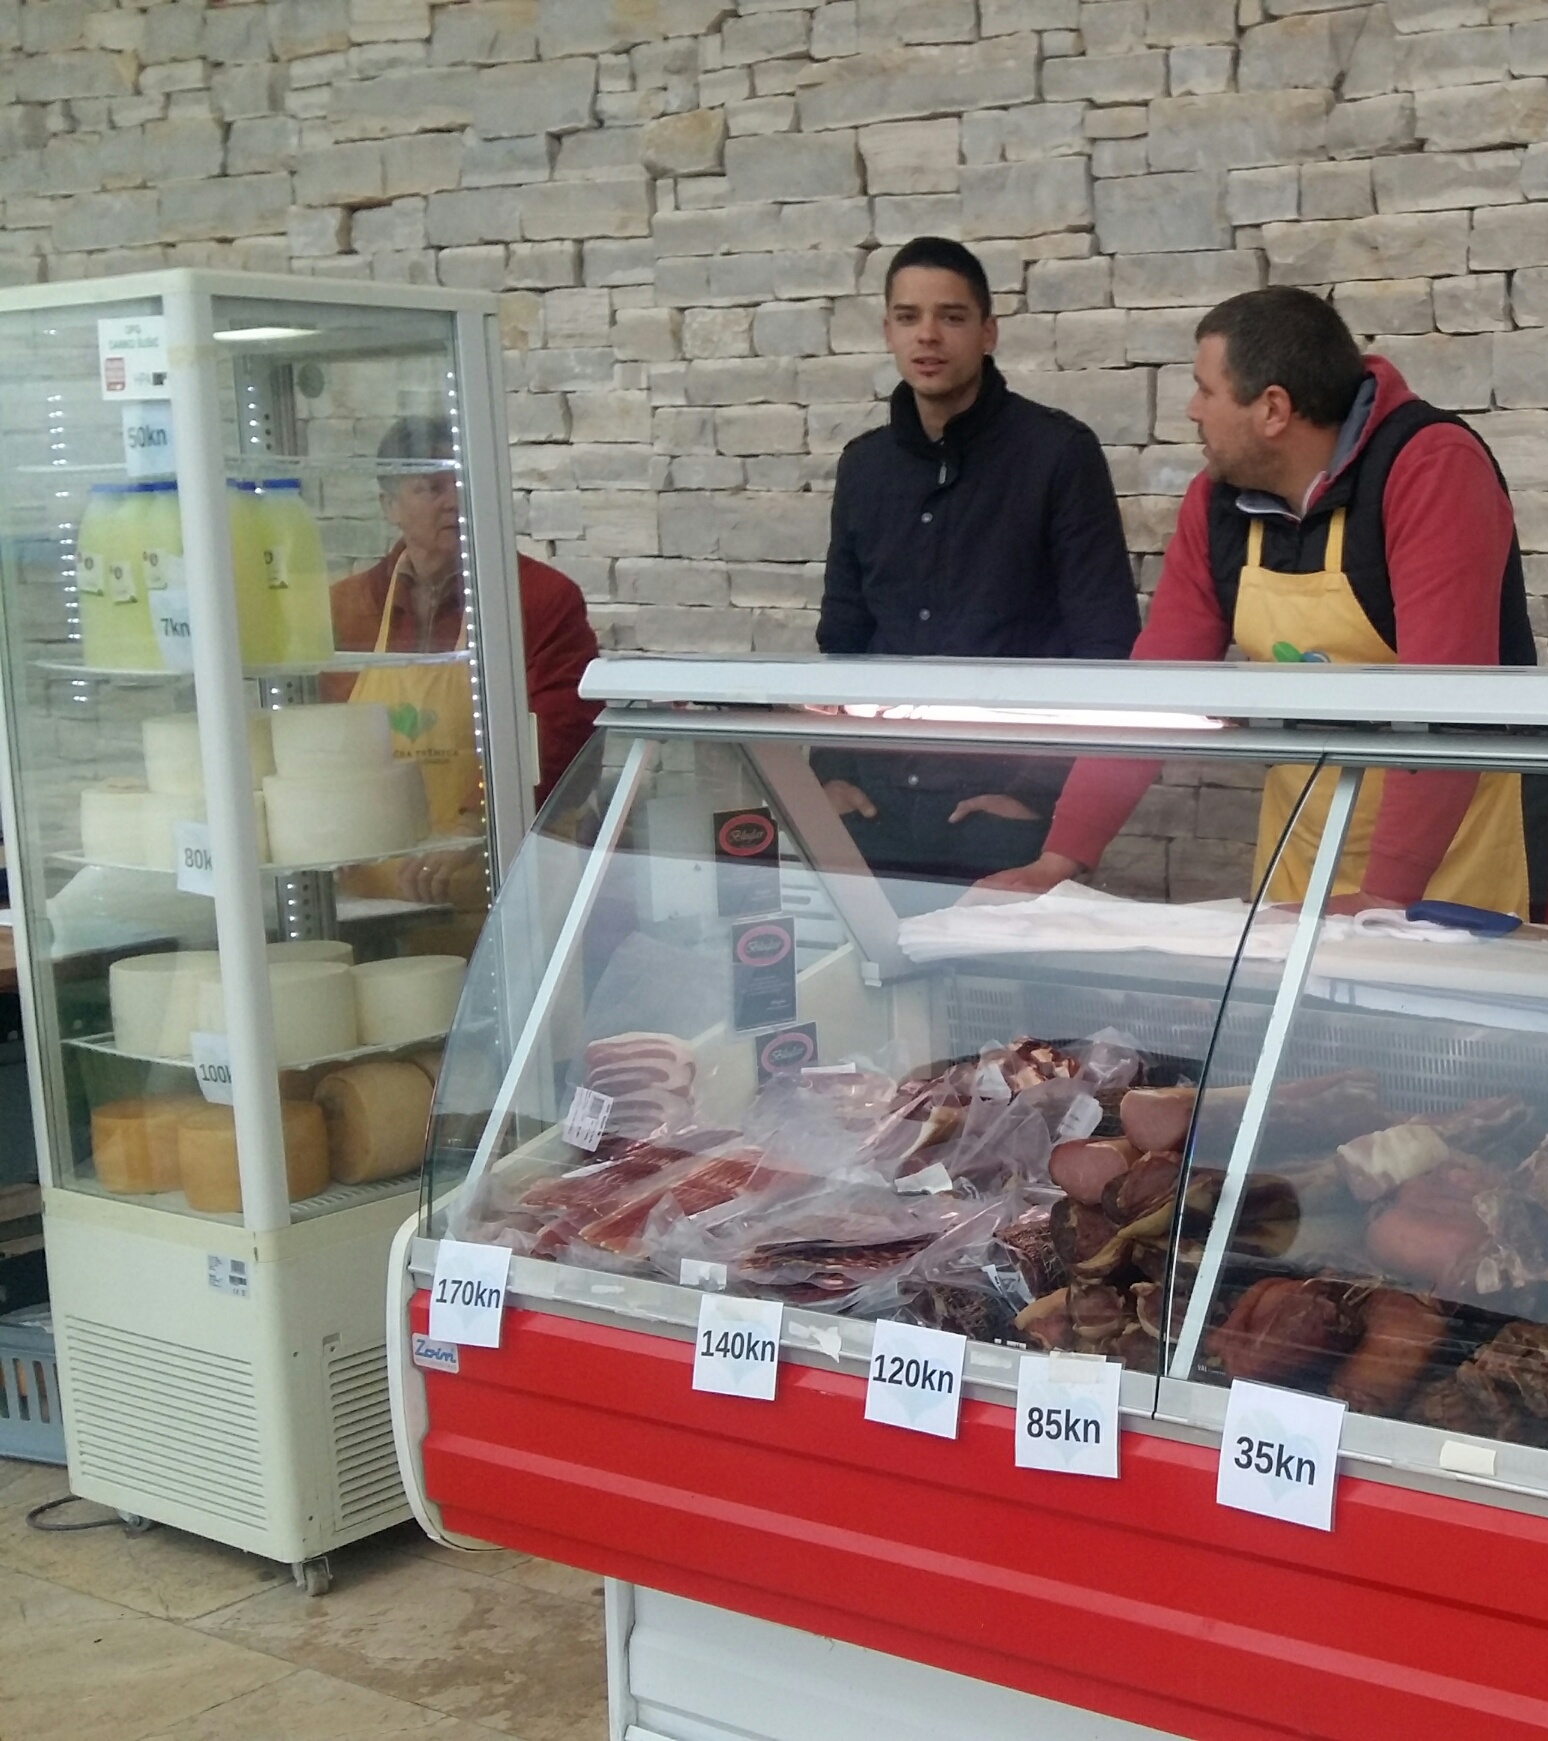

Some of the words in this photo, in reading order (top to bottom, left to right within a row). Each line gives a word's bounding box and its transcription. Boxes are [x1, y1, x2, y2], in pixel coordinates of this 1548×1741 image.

[127, 424, 168, 449] 50kn
[160, 617, 190, 638] 7kn
[184, 847, 213, 871] 80k
[199, 1063, 232, 1084] 100
[435, 1278, 501, 1308] 170kn
[700, 1330, 776, 1362] 140kn
[872, 1354, 955, 1394] 120kn
[1027, 1406, 1101, 1444] 85kn
[1234, 1436, 1317, 1486] 35kn
